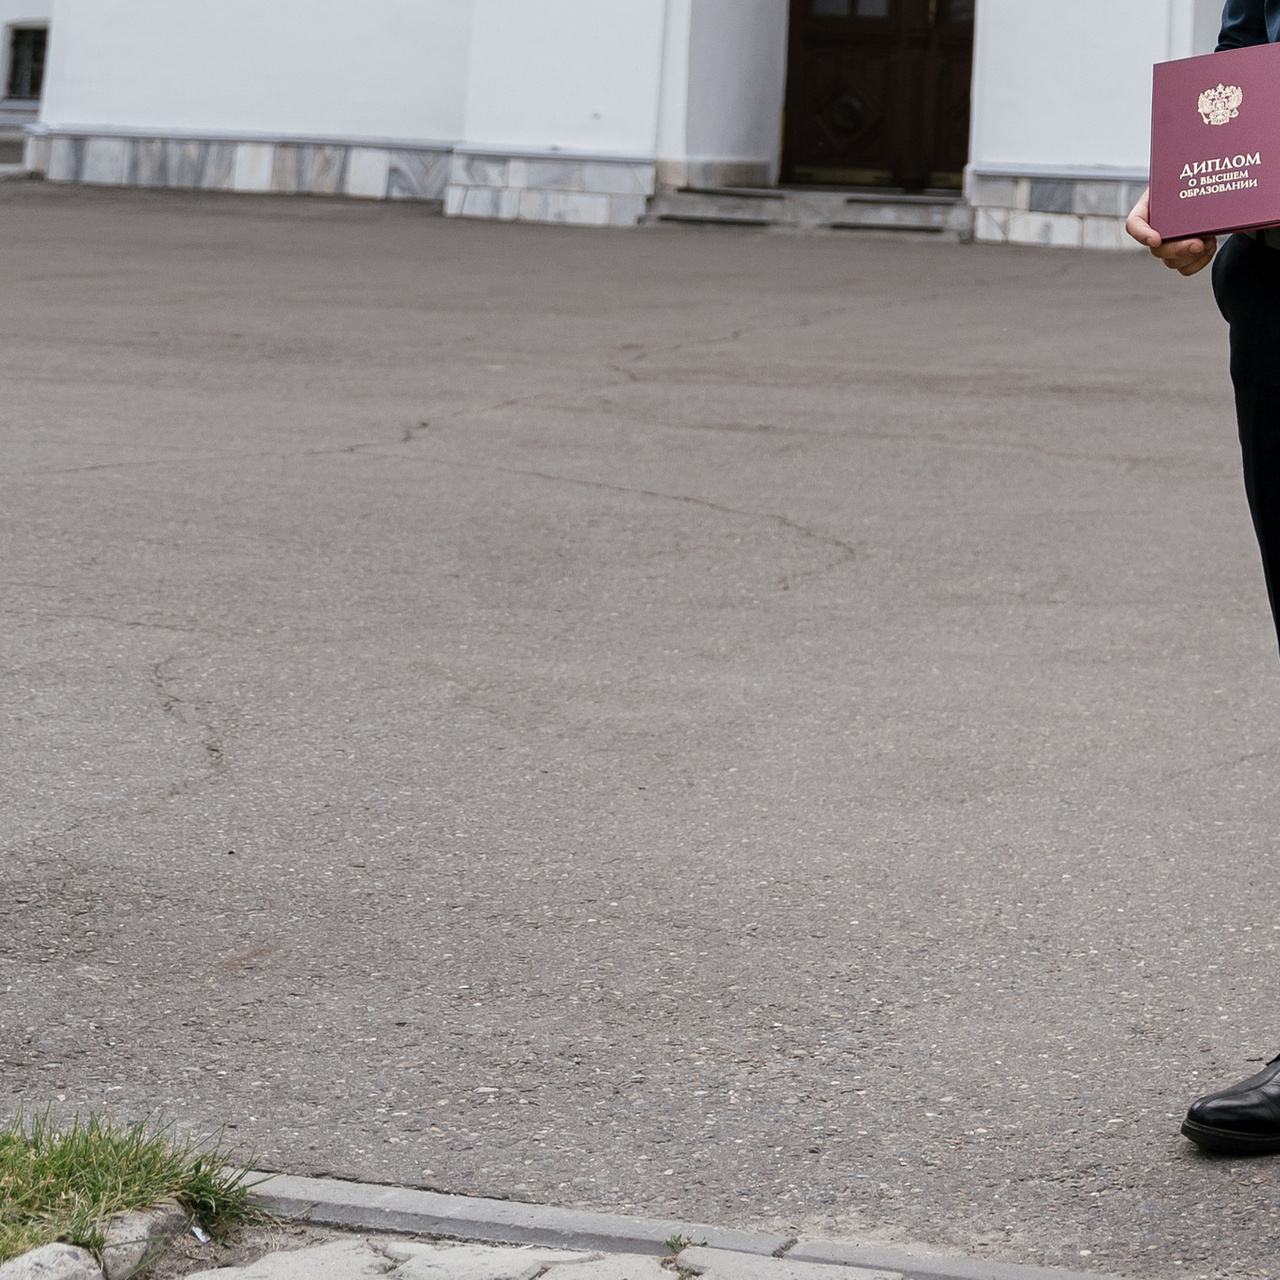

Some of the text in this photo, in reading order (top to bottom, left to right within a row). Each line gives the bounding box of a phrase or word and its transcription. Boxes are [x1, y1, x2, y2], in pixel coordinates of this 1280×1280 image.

[1179, 152, 1262, 180] ДИПЛОМ
[1179, 178, 1258, 199] ОБРАЗОВАНИИ
[1188, 169, 1249, 187] О ВЫСШЕМ
